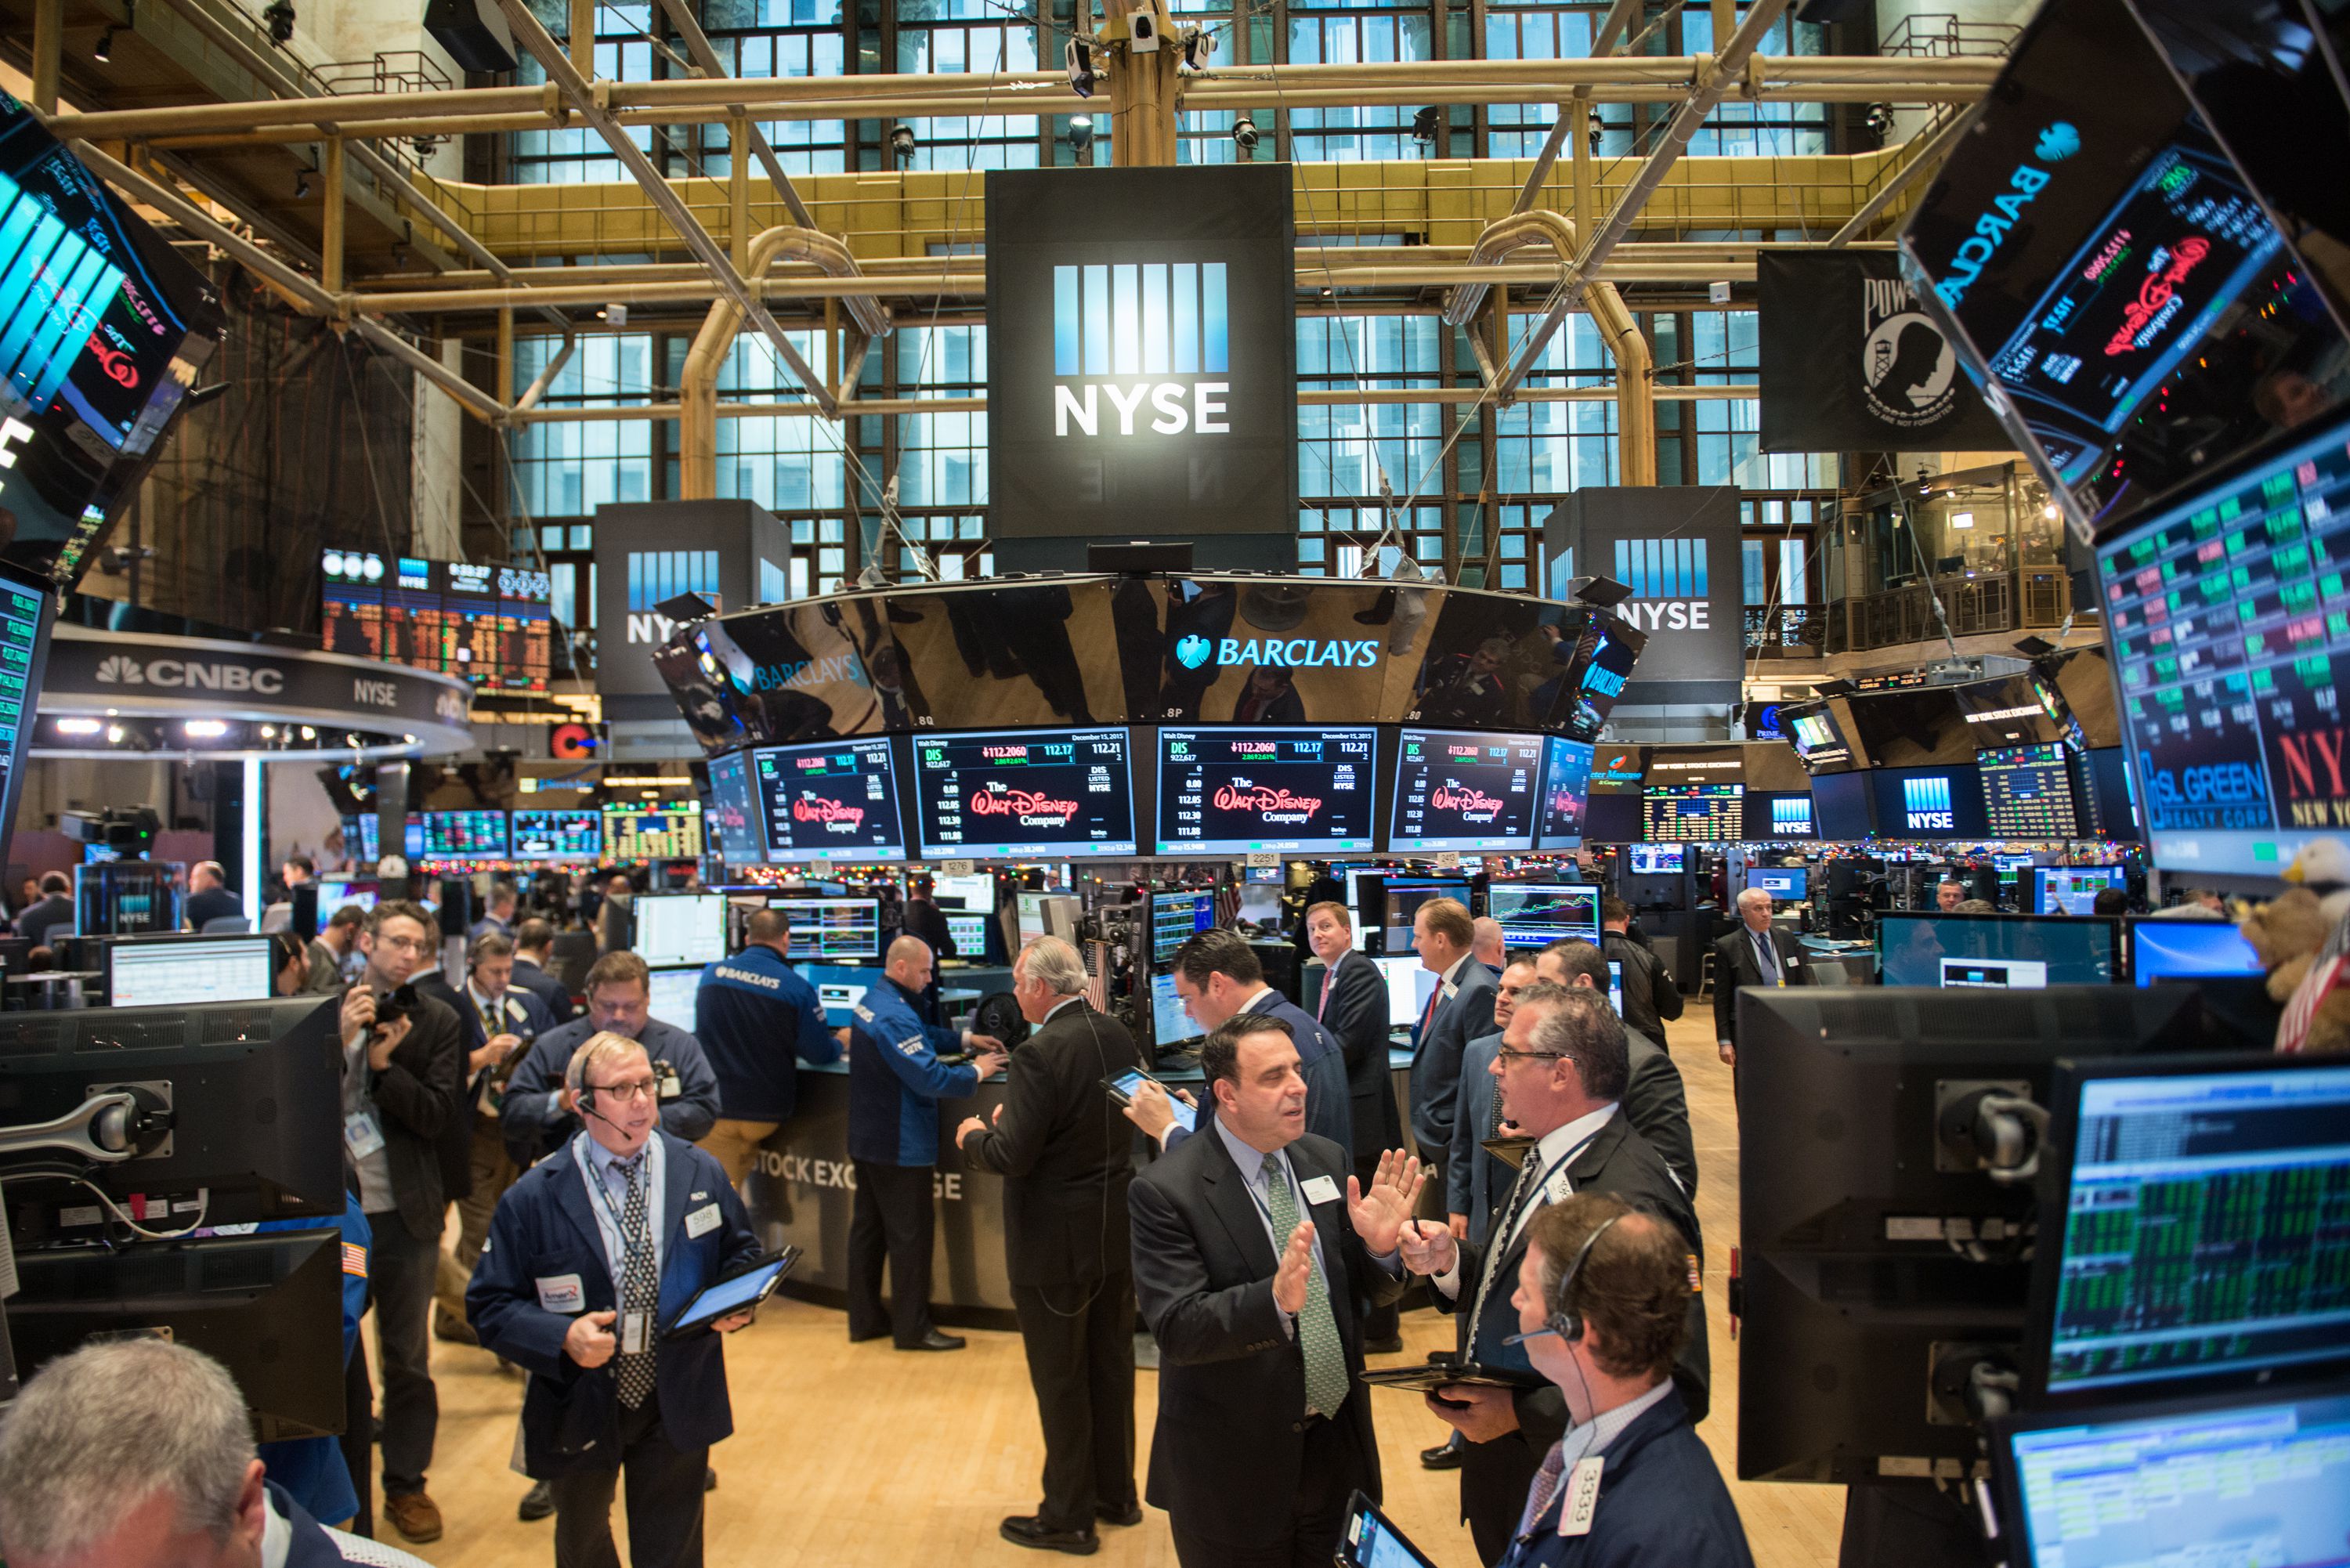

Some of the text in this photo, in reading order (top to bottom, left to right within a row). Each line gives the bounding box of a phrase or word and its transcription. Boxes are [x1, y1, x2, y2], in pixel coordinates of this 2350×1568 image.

[1055, 382, 1230, 436] NYSE
[1867, 403, 1954, 427] YOU ARE NOT FORGOTTEN
[399, 575, 428, 590] NYSE
[1617, 602, 1709, 630] NYSE
[1217, 639, 1379, 667] BARCLAYS
[146, 659, 283, 694] CNBC
[754, 654, 859, 691] BARCLAYS
[1589, 665, 1626, 698] BARCLAYS
[354, 678, 396, 706] NYSE
[925, 743, 1120, 761] DIS 112.2060 112.17 112.21
[1170, 742, 1368, 754] DIS 112.2060 112.17 112.21
[1407, 743, 1420, 755] DIS
[1489, 748, 1508, 757] 112.17
[1519, 749, 1536, 758] 112.21
[1607, 770, 1642, 779] Mancuso
[986, 782, 1007, 793] The
[1186, 779, 1202, 788] 0.00
[1231, 777, 1253, 788] The
[1446, 779, 1460, 788] The
[2183, 761, 2267, 802] GREEN
[801, 790, 816, 800] The
[1089, 784, 1111, 793] NYSE
[1020, 815, 1066, 828] Company
[1178, 811, 1201, 820] 112.30
[1262, 811, 1308, 824] Company
[1462, 811, 1494, 823] Company
[1907, 812, 1954, 828] NYSE
[826, 822, 857, 834] Company
[1773, 822, 1811, 833] NYSE
[1253, 854, 1274, 862] 2251
[1441, 853, 1455, 862] 2413
[948, 862, 967, 870] 1276
[119, 912, 150, 923] NYSE
[726, 969, 781, 990] BARCLAYS
[690, 1190, 707, 1201] RICH
[692, 1211, 714, 1225] 598
[1575, 1469, 1597, 1523] 3333
